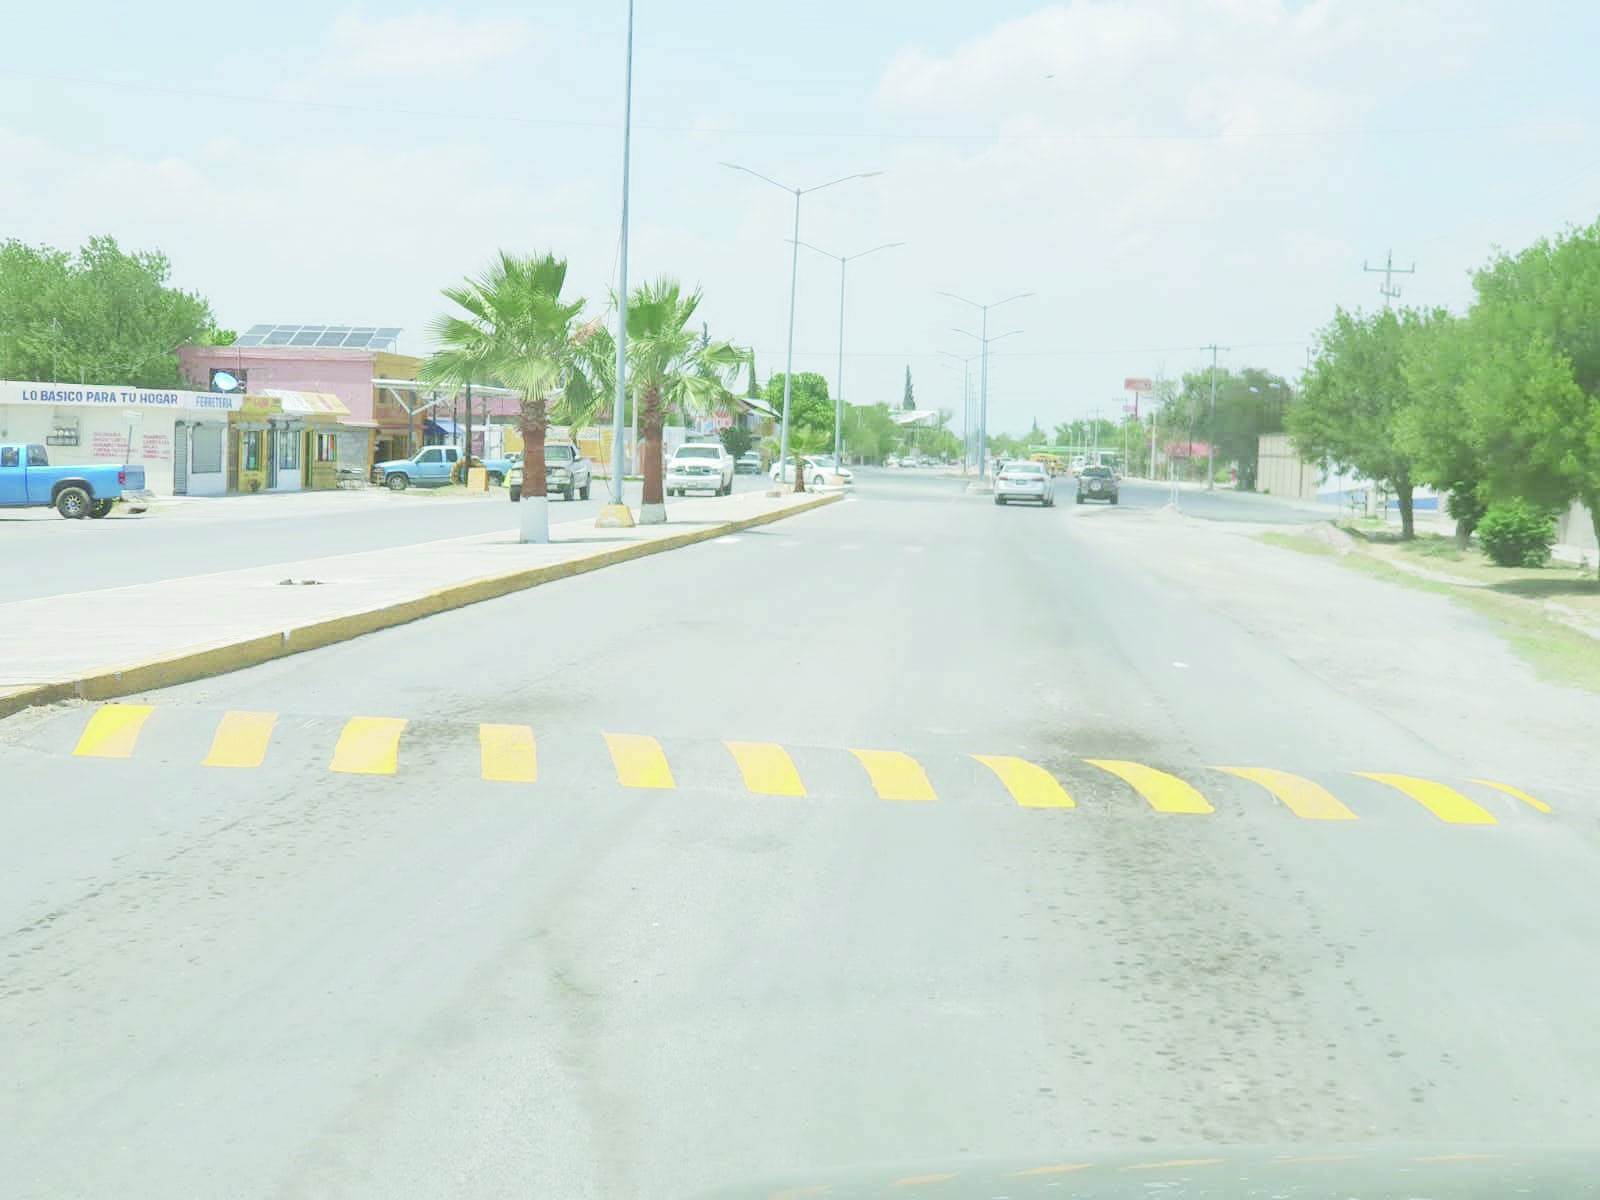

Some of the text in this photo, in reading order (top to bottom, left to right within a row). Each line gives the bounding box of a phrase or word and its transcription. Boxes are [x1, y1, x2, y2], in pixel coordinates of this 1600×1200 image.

[23, 390, 178, 405] LO BASICO PARA TU HOGAR
[196, 395, 232, 409] FERRETERIA
